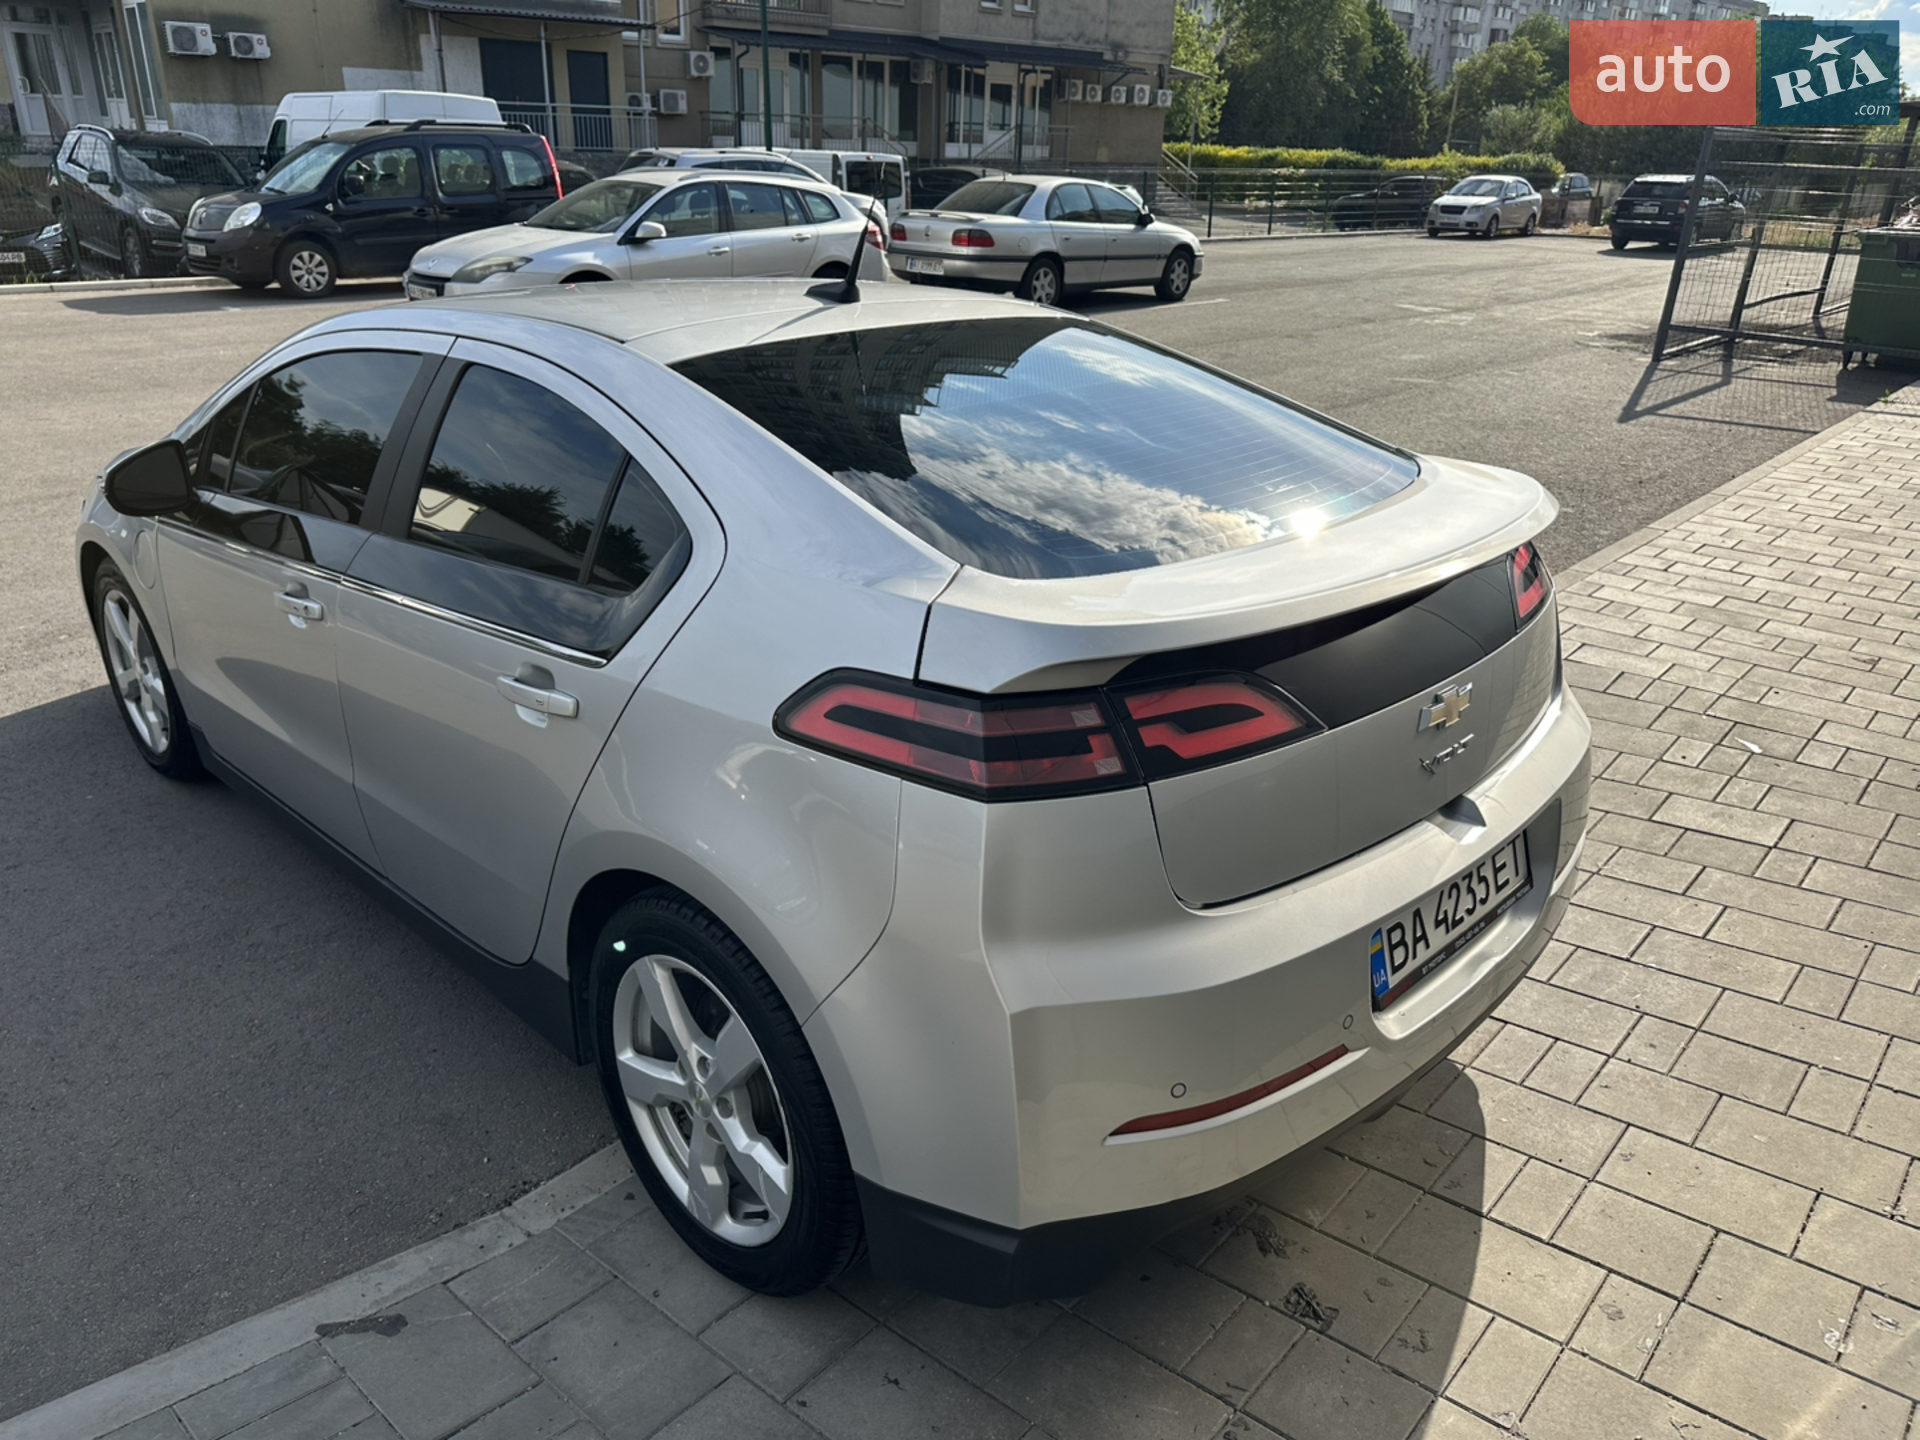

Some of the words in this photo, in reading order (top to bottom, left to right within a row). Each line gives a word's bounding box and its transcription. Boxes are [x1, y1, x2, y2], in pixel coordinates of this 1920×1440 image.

[1386, 907, 1430, 976] BA
[1434, 861, 1490, 935] 4235
[1491, 833, 1521, 895] ET
[1373, 968, 1388, 988] UA
